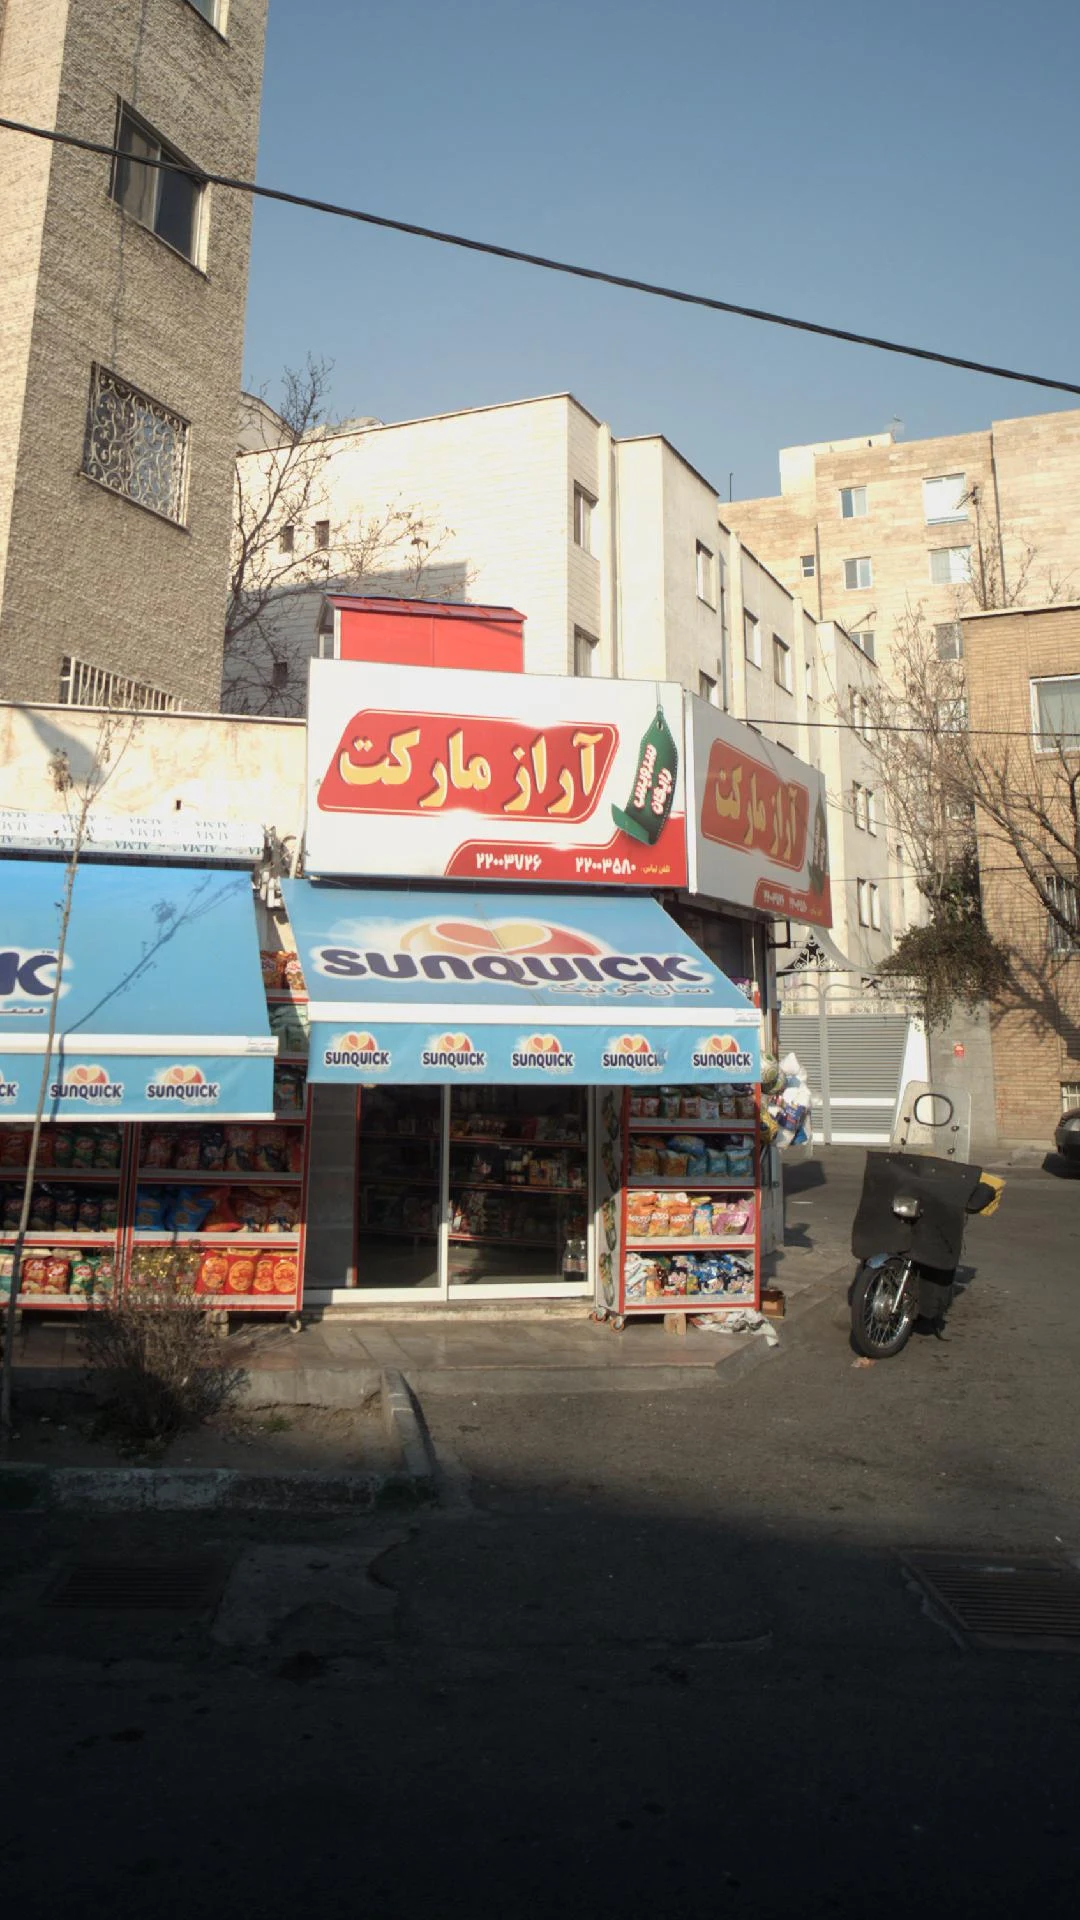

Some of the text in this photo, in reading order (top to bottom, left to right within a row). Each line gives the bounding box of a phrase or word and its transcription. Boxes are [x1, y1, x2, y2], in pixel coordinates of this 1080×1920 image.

[338, 726, 603, 815] آراز مارکت
[633, 744, 657, 808] سرویس
[651, 767, 672, 815] رایگان
[715, 766, 767, 845] مارکت
[770, 782, 798, 861] آراز
[476, 853, 542, 871] ۲۲۰۰۳۷۲۶
[575, 856, 636, 875] ۲۲۰۰۳۵۸۰
[320, 948, 704, 985] SUNQUICK
[649, 983, 710, 997] سان
[325, 1051, 389, 1068] SUNQUICK
[422, 1051, 485, 1068] SUNQUICK
[512, 1052, 573, 1068] SUNQUICK
[693, 1053, 751, 1068] SUNQUICK
[51, 1084, 122, 1100] SUNQUICK
[147, 1084, 218, 1100] SUNQUICK
